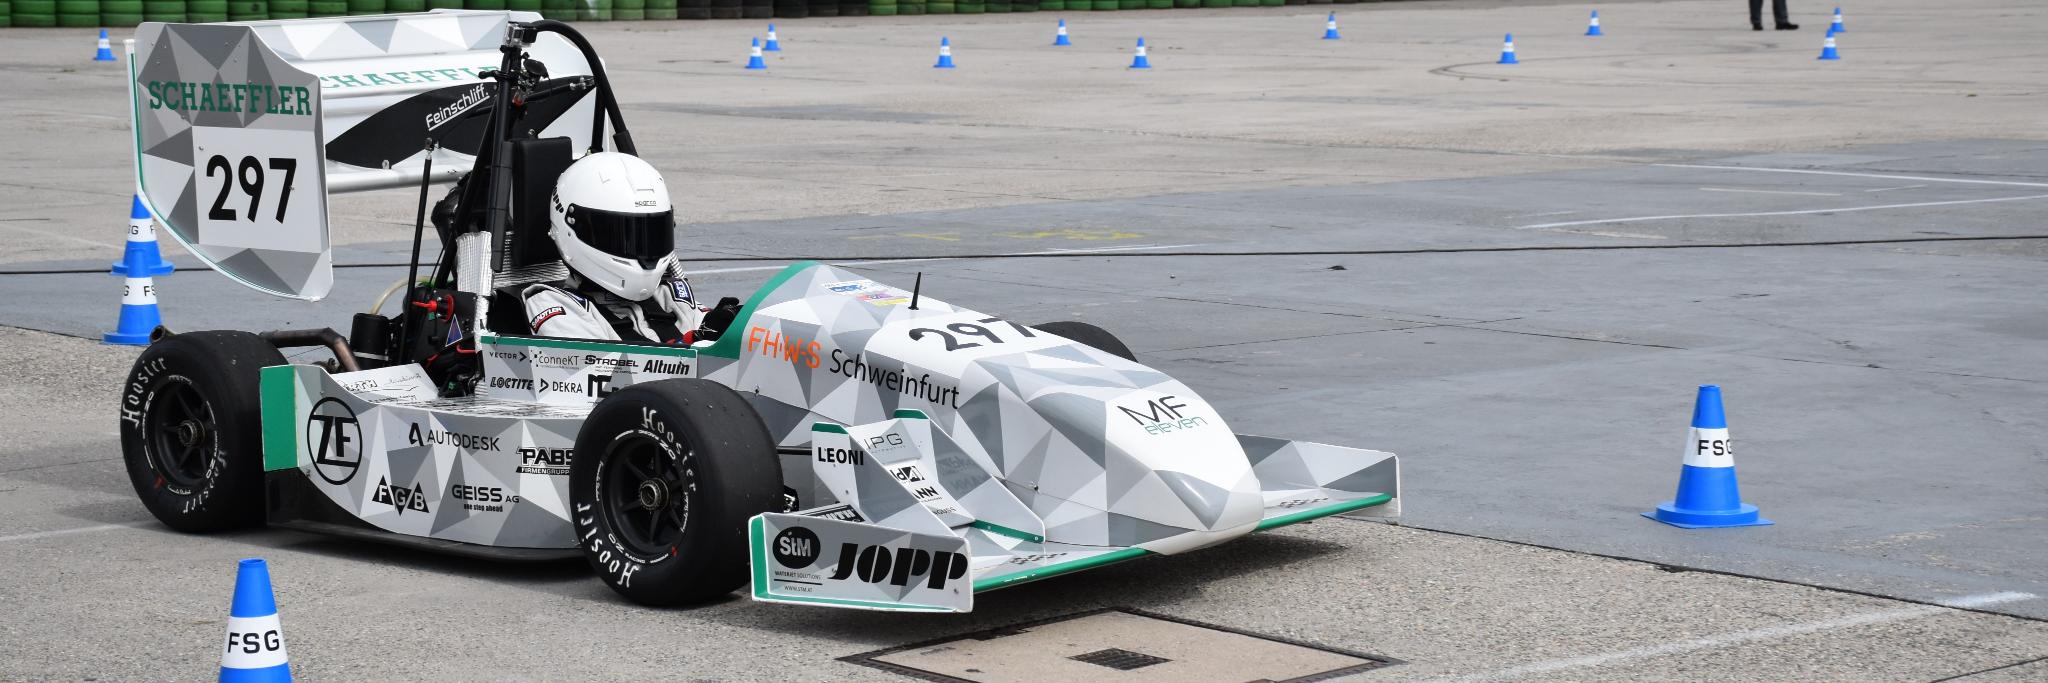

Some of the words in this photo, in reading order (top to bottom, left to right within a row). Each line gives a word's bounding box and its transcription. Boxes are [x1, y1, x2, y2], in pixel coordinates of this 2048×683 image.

[147, 80, 313, 115] SCHAEFFLER
[206, 154, 297, 224] 297
[909, 315, 1037, 352] 297
[489, 352, 517, 360] VECTOR
[584, 355, 639, 367] STROBEL
[643, 359, 691, 376] Altium
[489, 377, 534, 391] LOCTITE
[552, 381, 583, 394] DEKRA
[829, 349, 960, 410] Schweinfurt
[1117, 395, 1187, 425] MF
[1144, 416, 1209, 436] eleven
[310, 414, 359, 468] ZF
[427, 431, 500, 452] AUTODESK
[863, 432, 904, 450] IPG
[818, 446, 864, 466] LEONI
[521, 467, 570, 476] FIRMENGRUPP
[376, 482, 427, 511] FGB
[451, 484, 503, 503] GEISS
[505, 495, 520, 504] AG
[827, 543, 968, 590] JOPP
[227, 630, 280, 654] FSG
